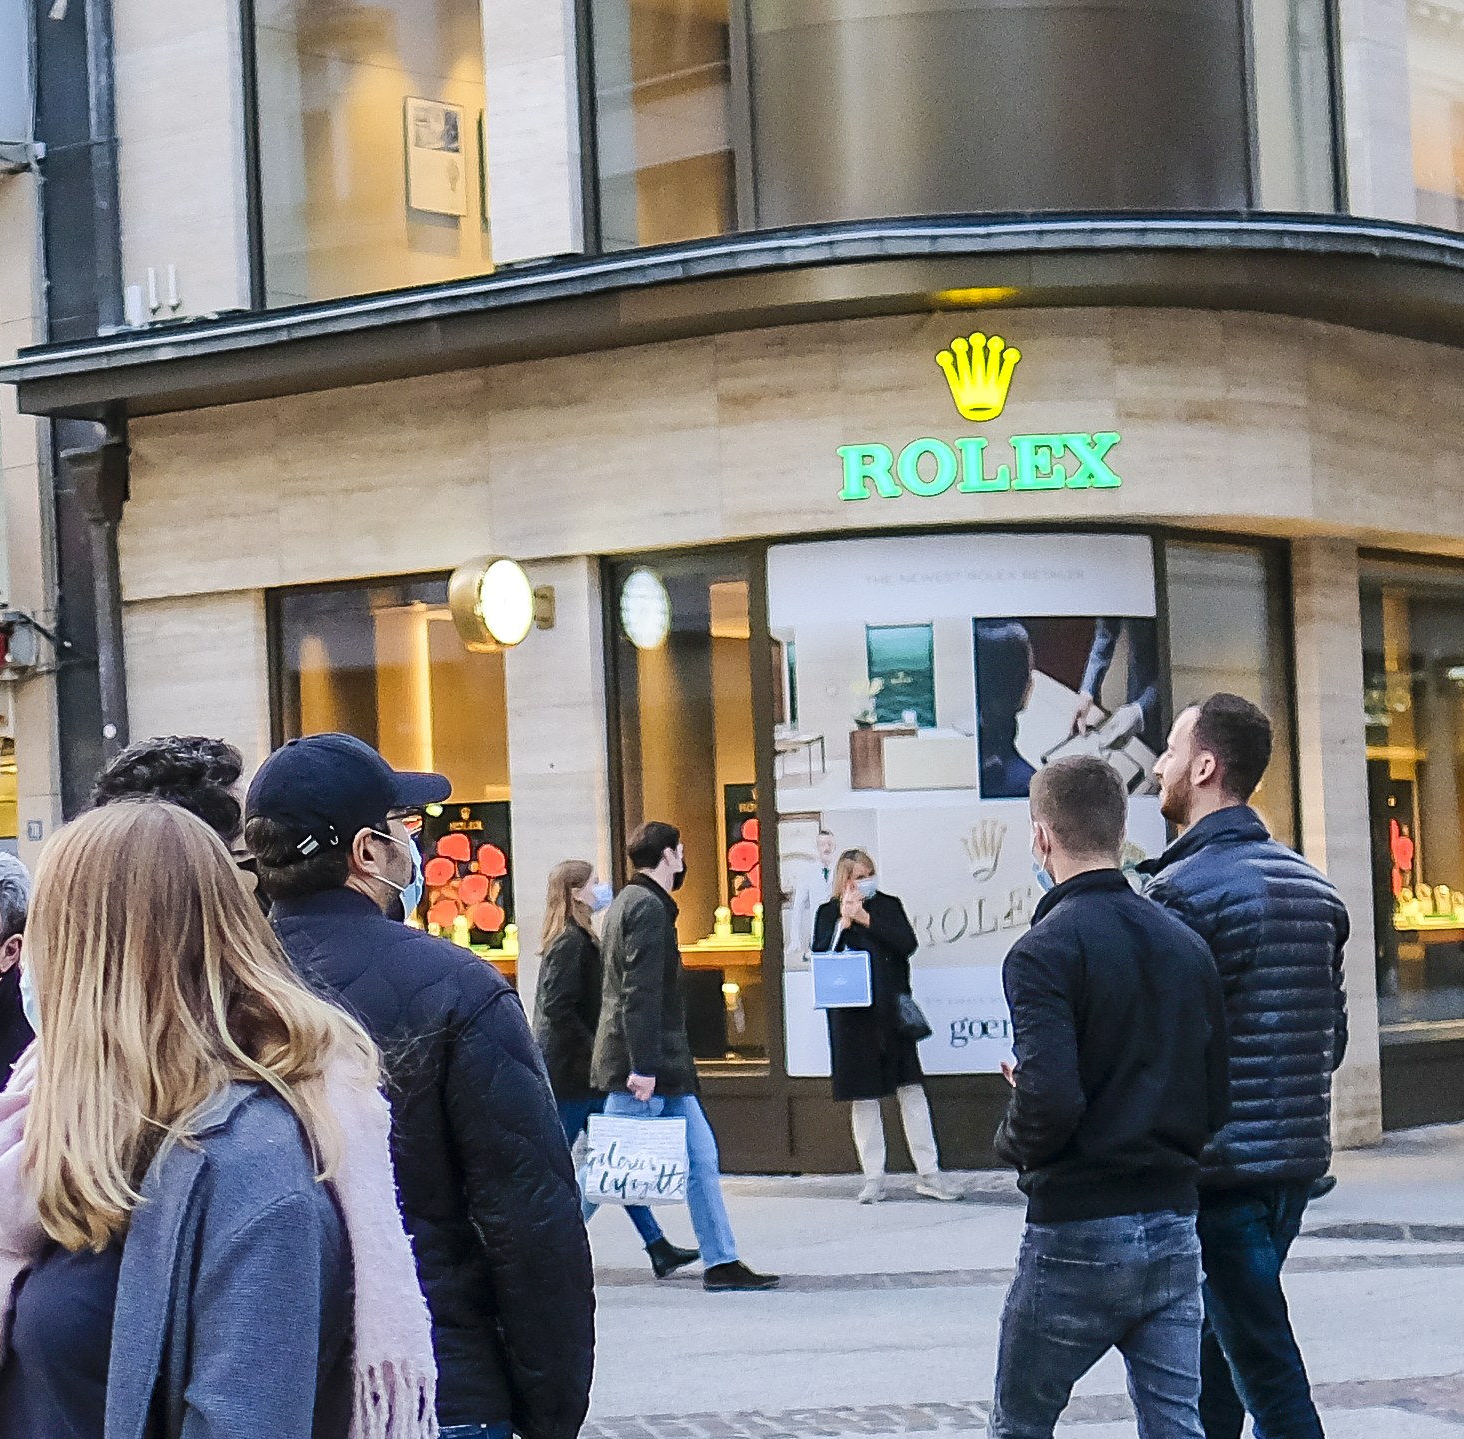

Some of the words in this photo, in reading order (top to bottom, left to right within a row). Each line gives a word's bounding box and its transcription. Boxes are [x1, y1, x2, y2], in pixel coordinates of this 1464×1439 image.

[836, 431, 1122, 500] ROLEX
[913, 887, 1033, 947] ROLE
[950, 1018, 1010, 1048] goer
